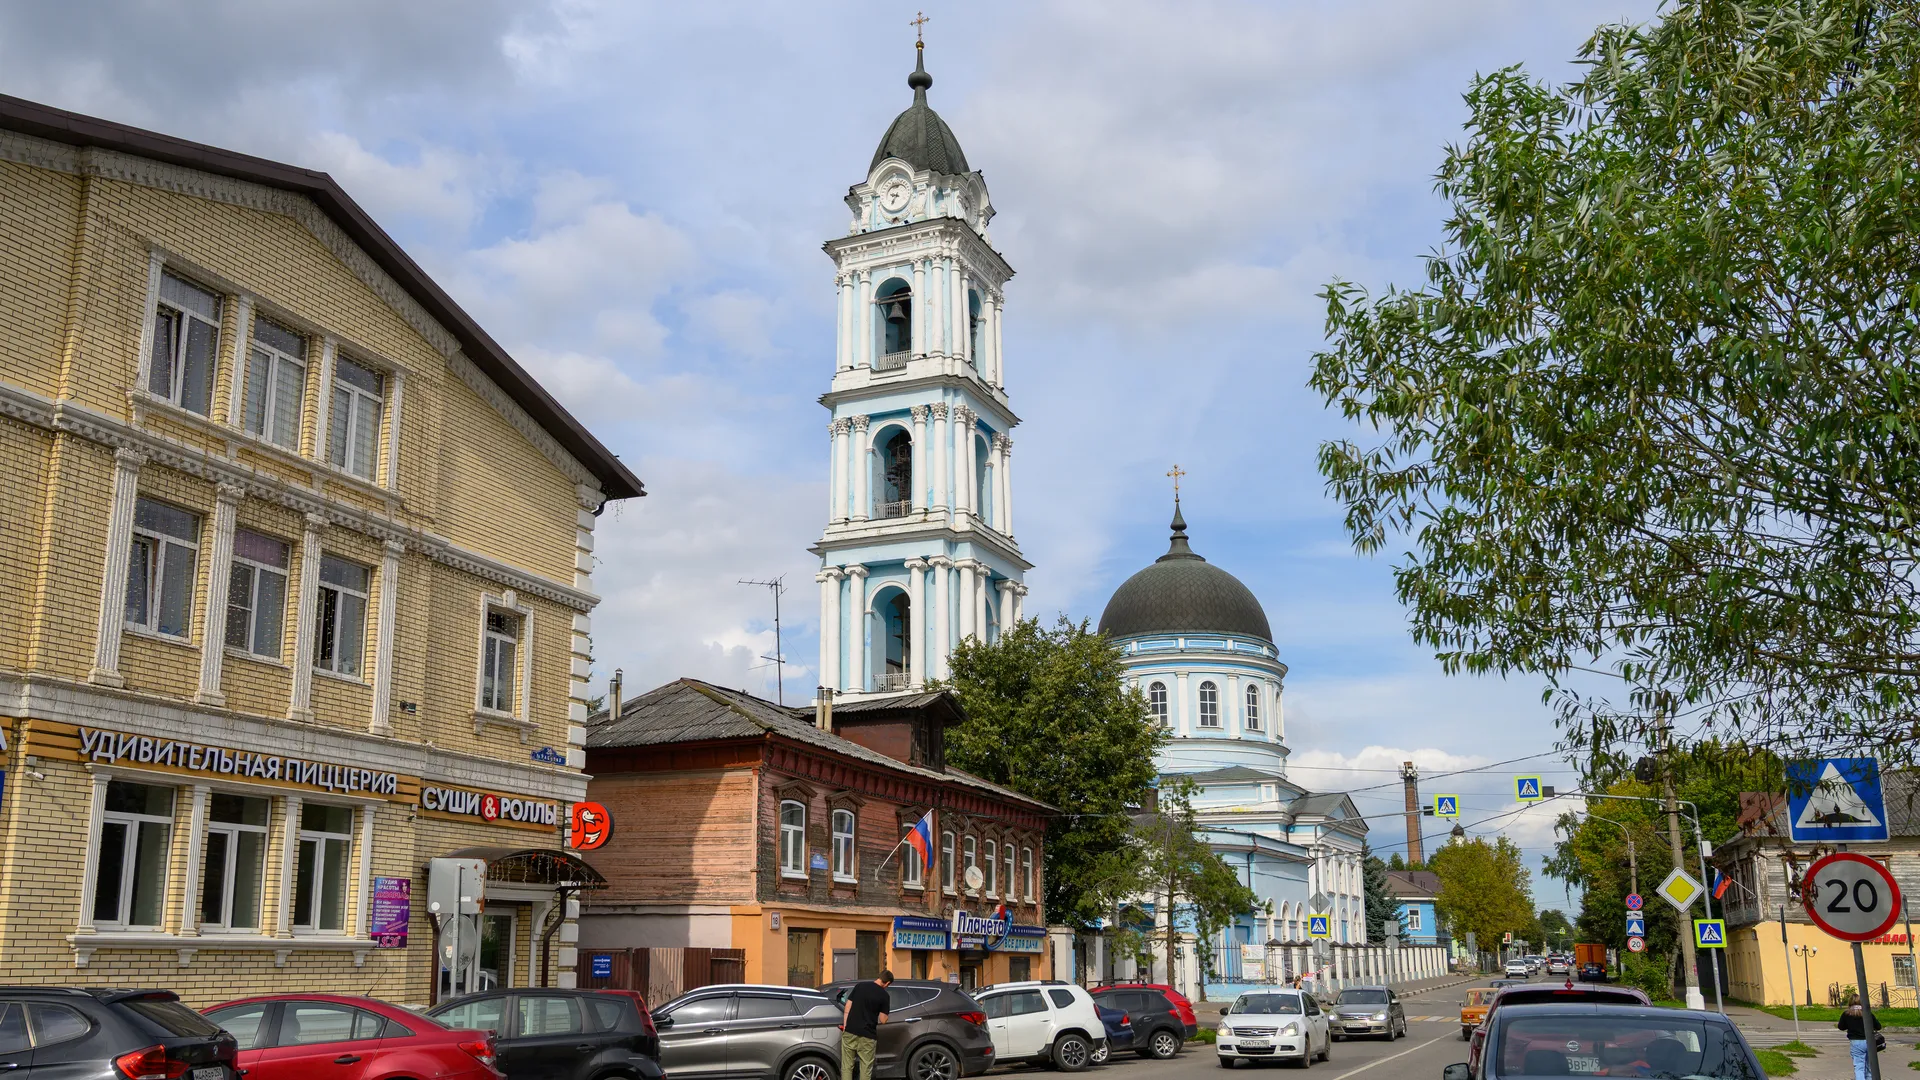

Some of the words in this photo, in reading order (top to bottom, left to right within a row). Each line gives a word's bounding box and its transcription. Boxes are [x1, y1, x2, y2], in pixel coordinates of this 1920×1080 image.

[78, 727, 280, 780] УДИВИТЕЛЬНАЯ
[284, 758, 397, 795] ПИЦЦЕРИЯ
[422, 786, 480, 816] СУШИ
[484, 797, 497, 818] &
[500, 797, 557, 825] РОЛЛЫ
[1825, 879, 1878, 913] 20
[957, 911, 1006, 936] Планета
[897, 932, 911, 945] ВСЕ
[912, 933, 926, 947] ДЛЯ
[926, 934, 945, 947] ДОМА
[1004, 938, 1014, 949] ВСЕ
[1015, 938, 1025, 950] ДЛЯ
[1025, 939, 1038, 949] ДАЧИ
[1631, 940, 1641, 949] 20
